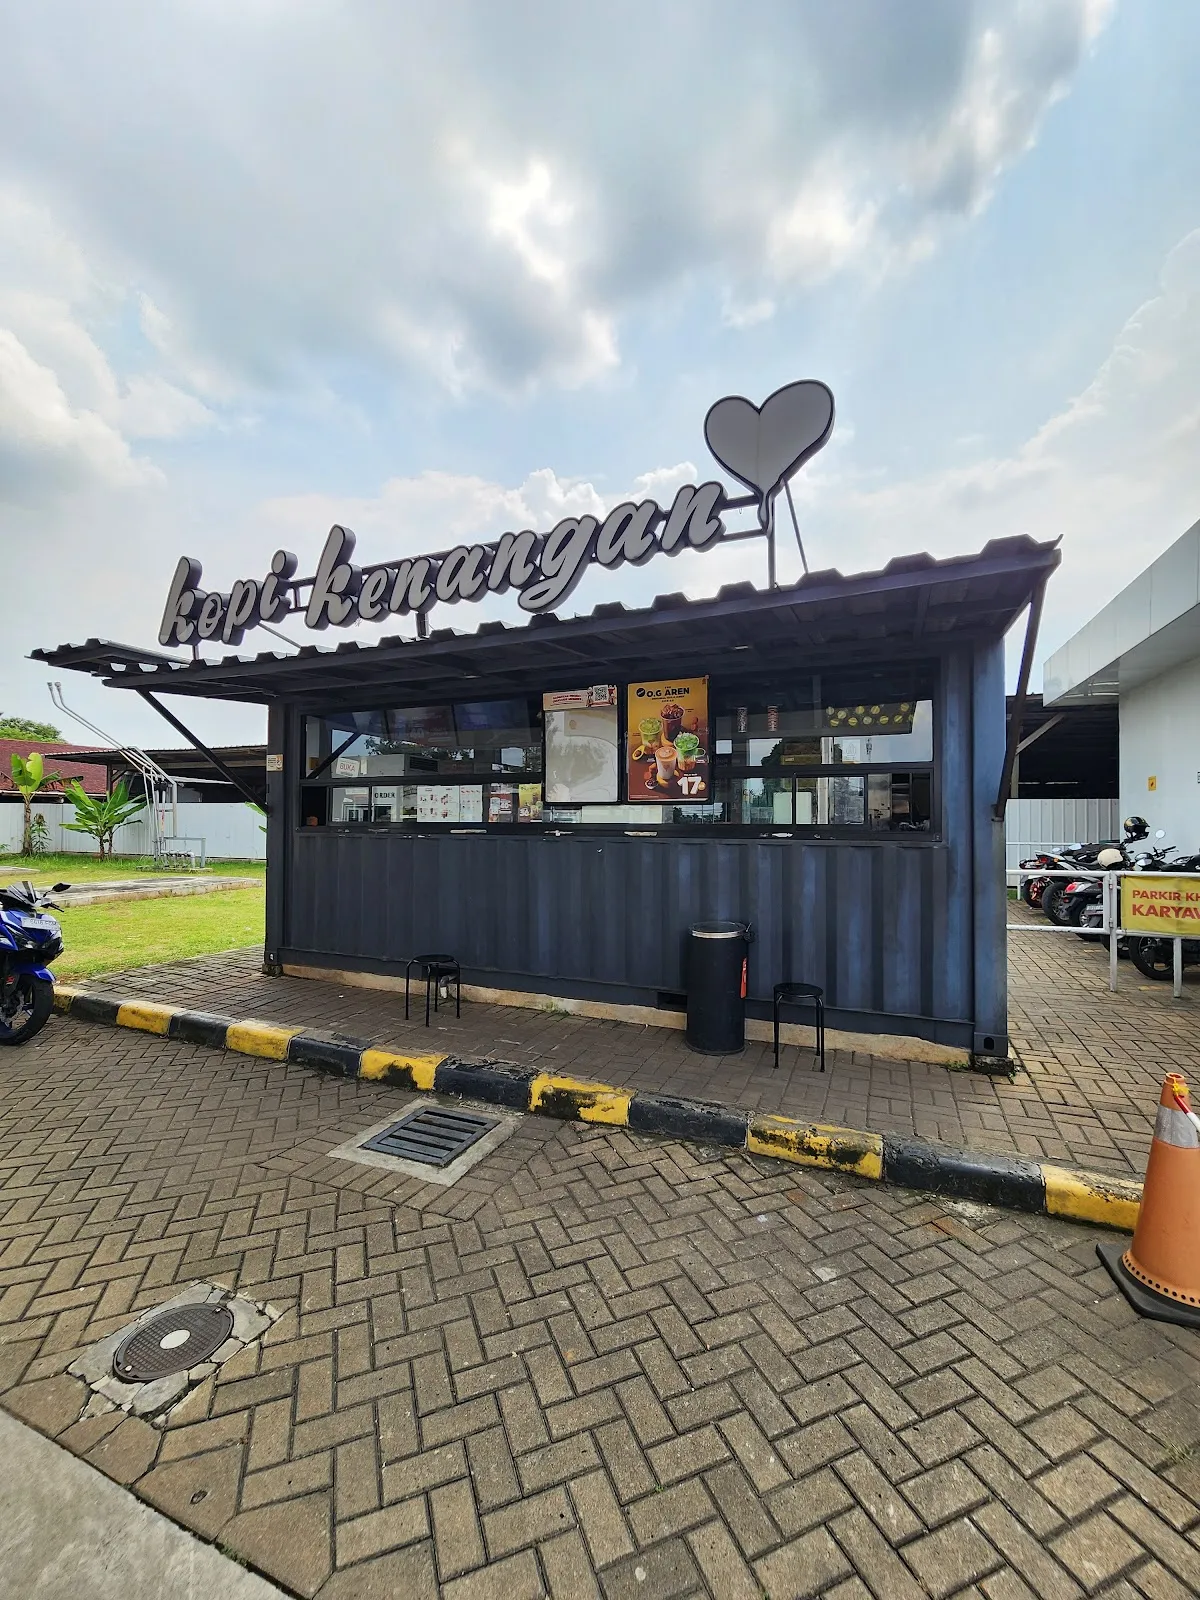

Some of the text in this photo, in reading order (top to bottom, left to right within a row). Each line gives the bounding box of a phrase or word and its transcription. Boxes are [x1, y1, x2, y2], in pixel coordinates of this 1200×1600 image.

[158, 480, 729, 647] kopi kenangan
[646, 689, 662, 698] O.G
[664, 687, 690, 696] AREN
[676, 776, 702, 796] 17
[1132, 889, 1182, 901] PARKIR
